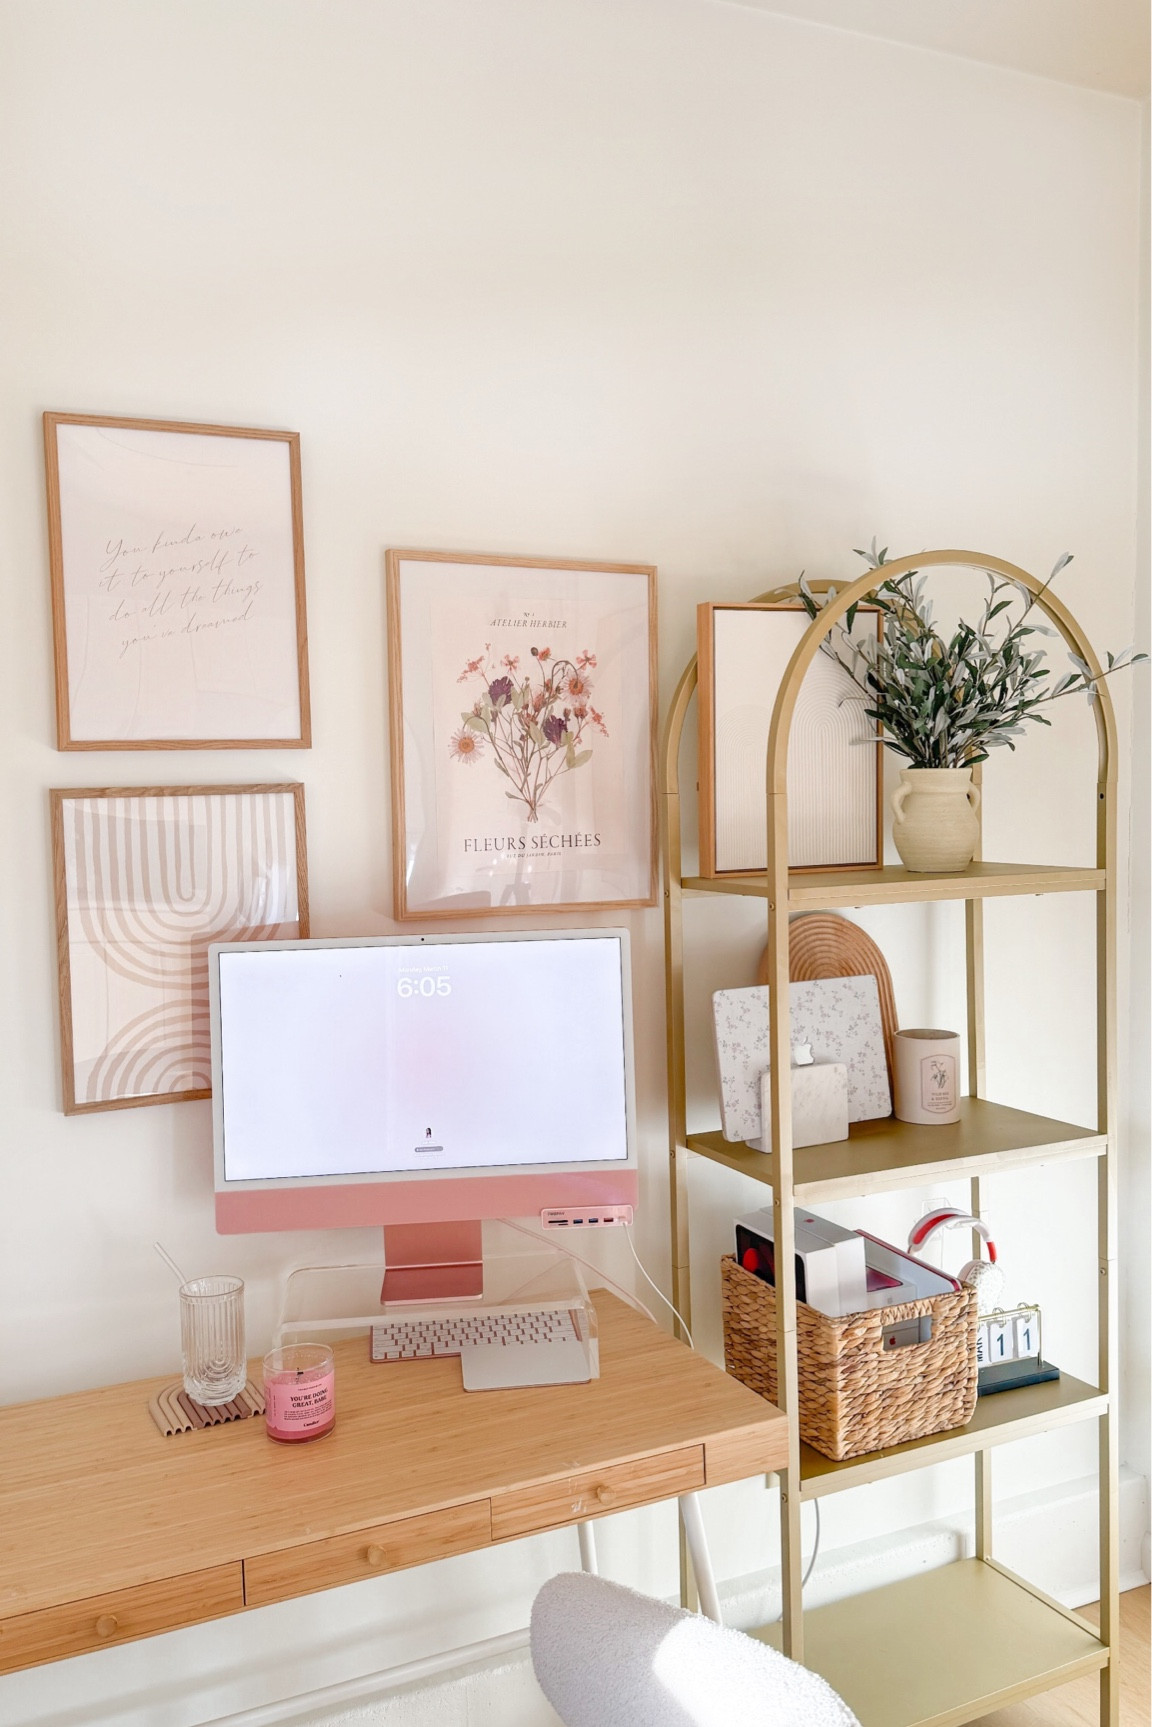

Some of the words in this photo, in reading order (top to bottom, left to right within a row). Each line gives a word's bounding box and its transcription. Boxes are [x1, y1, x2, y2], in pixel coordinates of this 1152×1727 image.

[100, 539, 145, 572] You
[152, 523, 205, 553] kinda
[99, 568, 123, 592] it
[131, 565, 152, 587] to
[157, 549, 234, 589] yourself
[237, 544, 260, 566] to
[109, 599, 136, 621] do
[142, 591, 174, 617] all
[180, 586, 206, 609] the
[212, 578, 263, 604] things
[181, 600, 254, 633] dreamed
[490, 619, 528, 628] ATELIER
[529, 620, 568, 629] HERBIER
[464, 836, 526, 852] FLEURS
[531, 832, 602, 850] SÉCHÉES
[397, 975, 452, 998] 6:05
[997, 1334, 1004, 1356] 1
[1023, 1329, 1030, 1350] 1
[290, 1394, 312, 1402] YOU'RE
[312, 1388, 328, 1398] DOING
[314, 1396, 326, 1404] BABE
